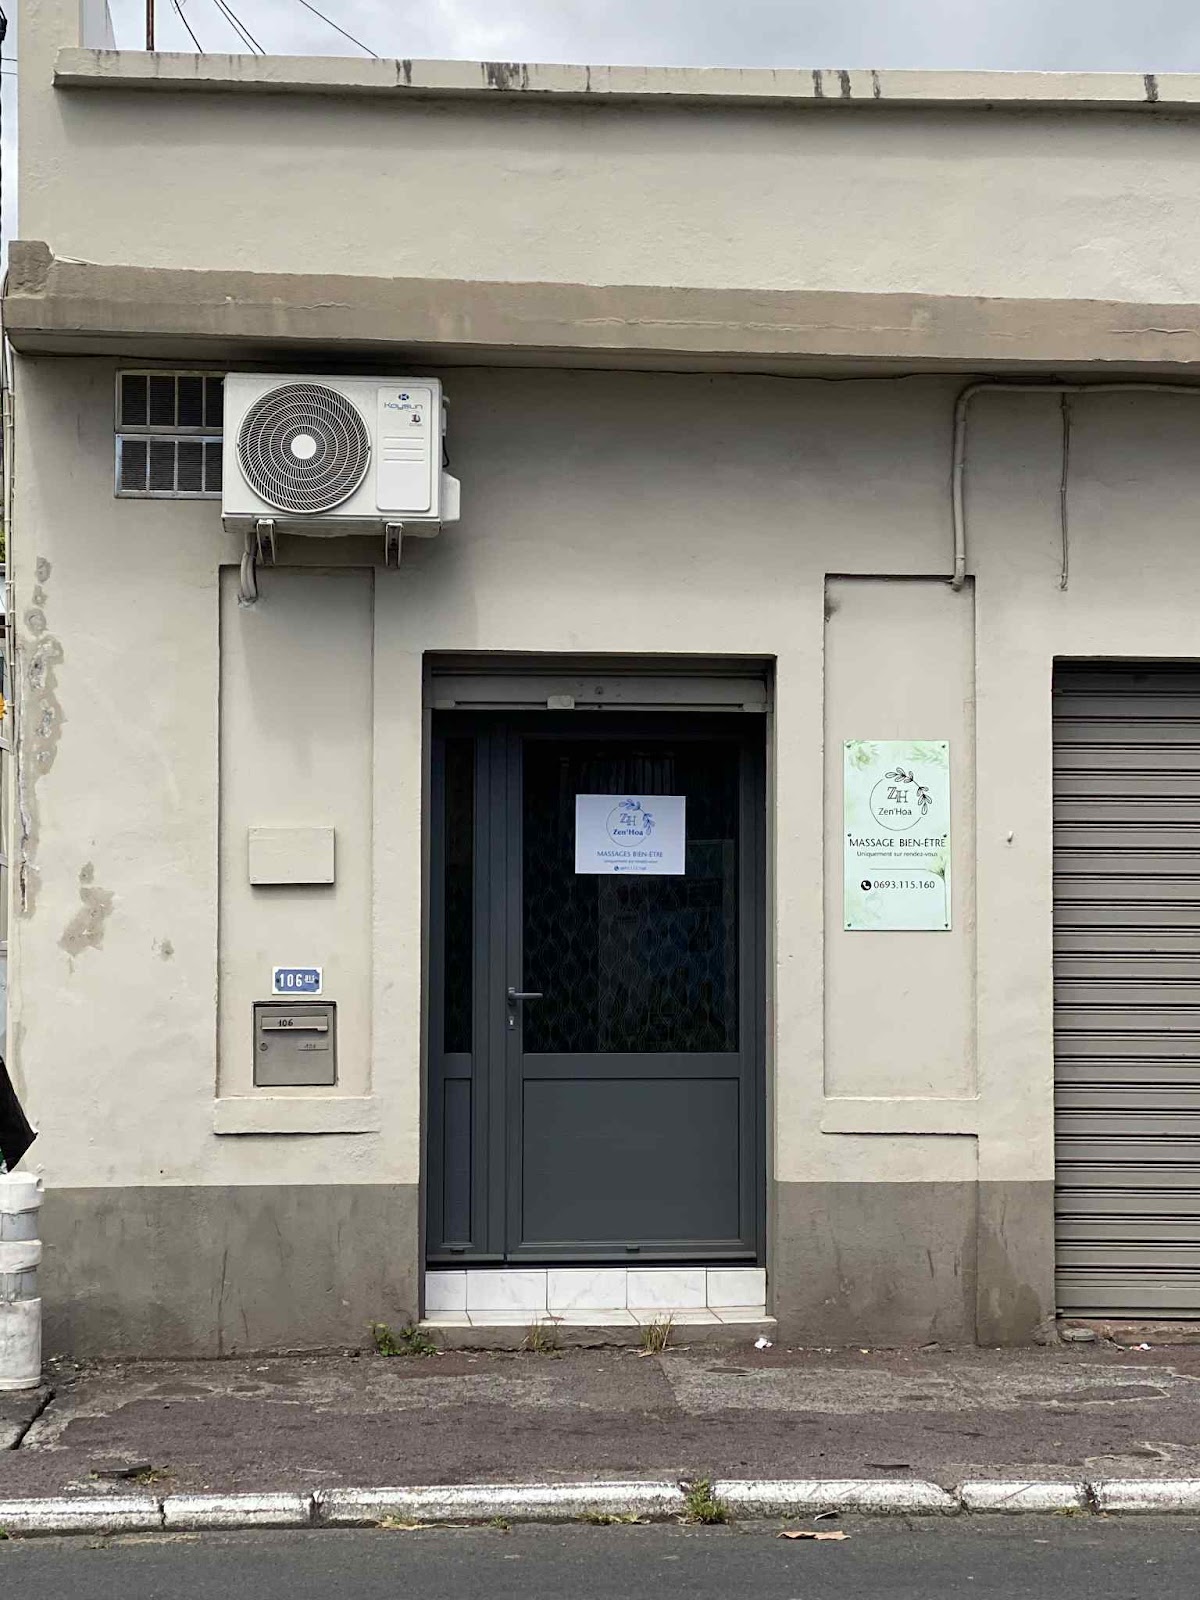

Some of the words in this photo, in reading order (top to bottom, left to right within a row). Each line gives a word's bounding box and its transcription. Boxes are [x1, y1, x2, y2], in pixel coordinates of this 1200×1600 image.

[878, 808, 912, 816] Zen'Hoa
[613, 828, 643, 836] Zen'Hoa
[849, 838, 895, 847] MASSAGE
[873, 880, 935, 889] 0693.115.160
[280, 974, 303, 987] 106
[278, 1019, 294, 1027] 106
